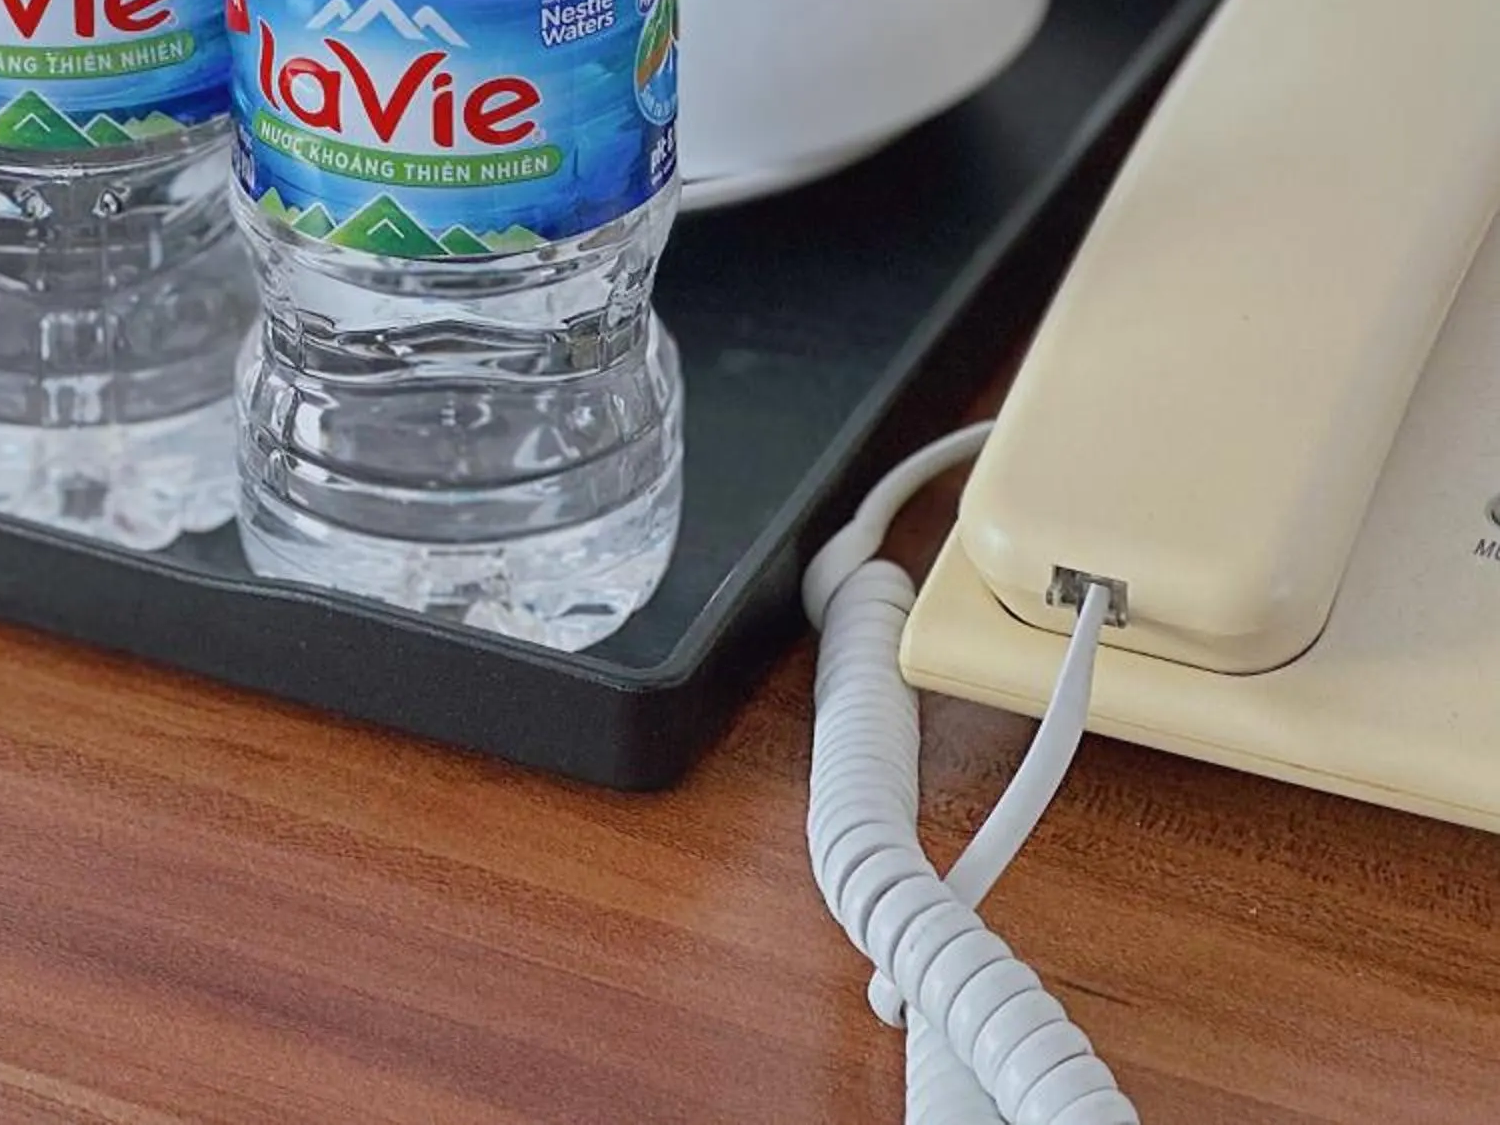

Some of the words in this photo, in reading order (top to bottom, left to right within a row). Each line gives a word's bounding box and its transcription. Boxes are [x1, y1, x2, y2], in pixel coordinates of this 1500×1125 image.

[541, 10, 615, 47] Waters
[48, 51, 112, 75] THIÊN
[121, 38, 185, 69] NHIÊN
[403, 161, 471, 183] THIÊN
[481, 153, 549, 181] NHIÊN
